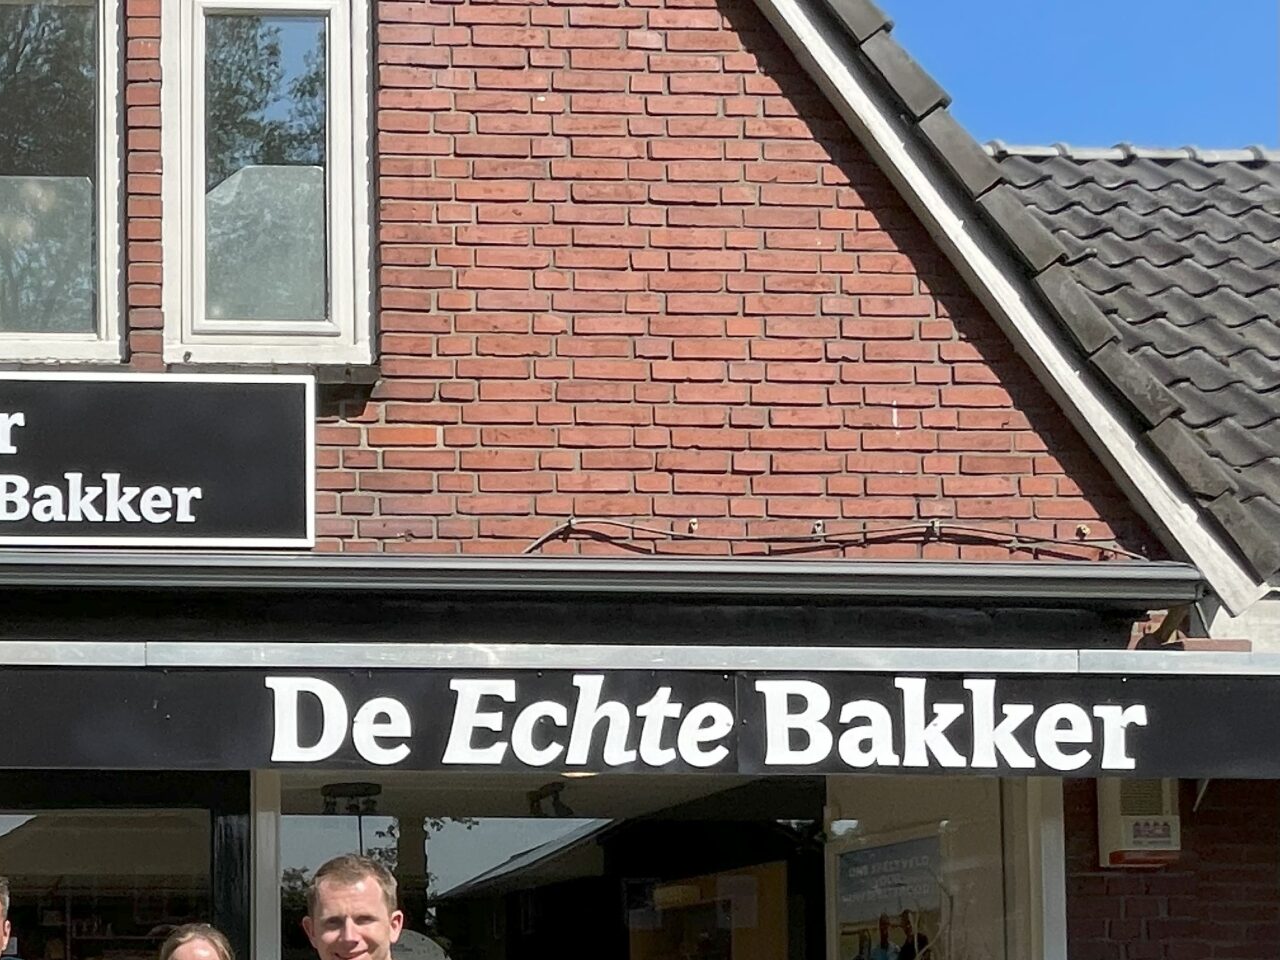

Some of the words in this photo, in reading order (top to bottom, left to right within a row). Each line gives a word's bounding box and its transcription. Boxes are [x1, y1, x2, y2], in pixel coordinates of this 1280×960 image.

[265, 676, 411, 765] De
[441, 674, 733, 767] Echte
[755, 676, 1148, 771] Bakker
